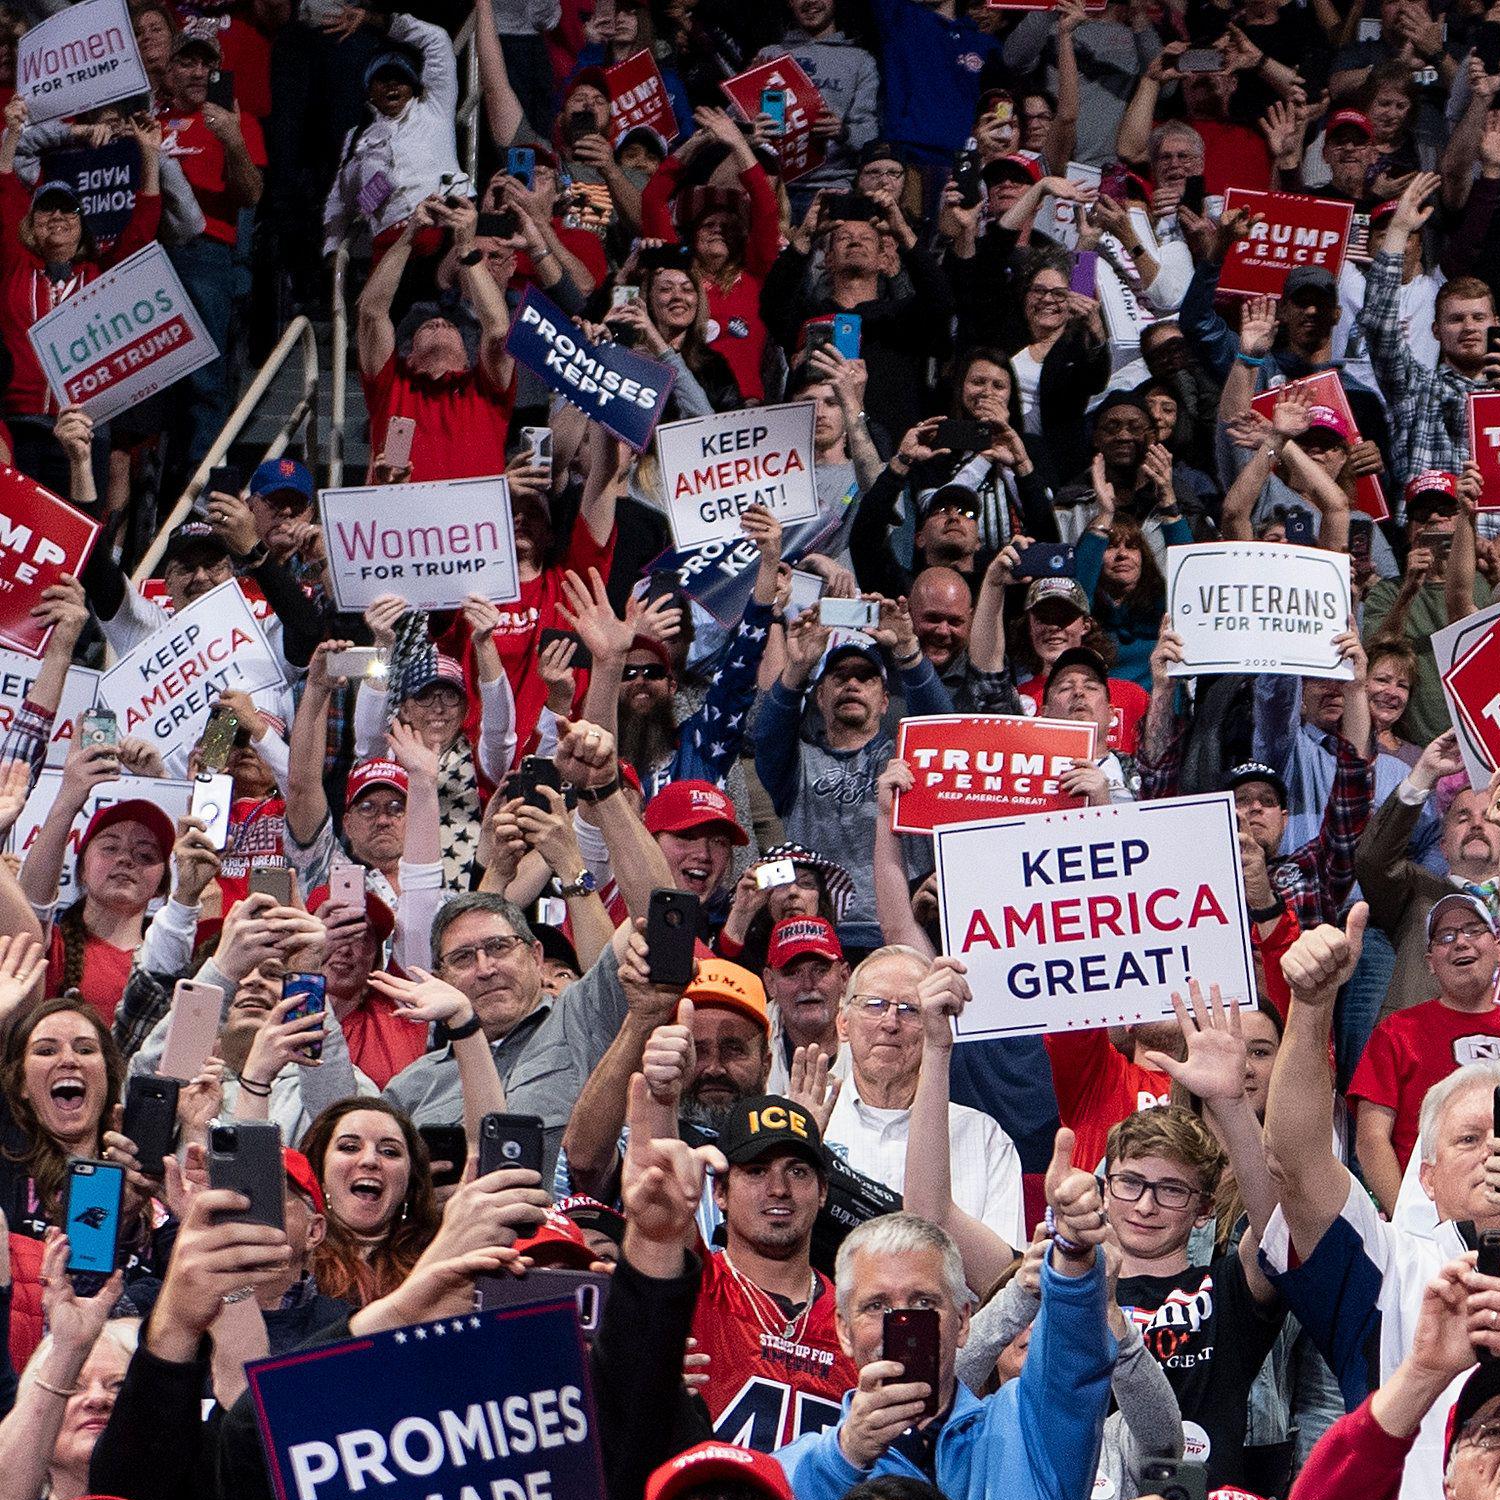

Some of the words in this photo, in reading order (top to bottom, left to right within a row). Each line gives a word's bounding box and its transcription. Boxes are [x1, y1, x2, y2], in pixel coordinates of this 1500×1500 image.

[22, 27, 126, 84] Women
[32, 79, 62, 96] FOR
[67, 59, 119, 85] TRUMP
[607, 77, 659, 117] RUMP
[615, 96, 662, 130] ENCE
[78, 165, 130, 191] MADE
[1236, 241, 1326, 264] PENCE
[1250, 224, 1340, 246] RUMP
[50, 291, 174, 375] Latinos
[69, 366, 111, 402] FOR
[112, 327, 186, 381] TRUMP
[521, 305, 657, 410] PROMISES
[545, 349, 617, 407] KEPT
[701, 427, 768, 459] KEEP
[674, 448, 804, 500] AMERICA
[336, 518, 499, 561] Women
[361, 561, 405, 580] FOR
[412, 557, 487, 578] TRUMP
[1199, 584, 1337, 619] VETERANS
[1214, 616, 1250, 633] FOR
[1257, 617, 1324, 635] TRUMP
[139, 623, 202, 679] KEEP
[1245, 659, 1277, 667] 2020
[125, 629, 254, 732] AMERICA
[913, 749, 1074, 774] TRUMP
[926, 772, 1059, 795] PENCE
[938, 791, 962, 802] KEEP
[964, 792, 1009, 804] AMERICA
[1011, 795, 1047, 806] GREAT!
[1022, 839, 1150, 887] KEEP
[961, 884, 1230, 953] AMERICA
[694, 974, 746, 996] RUMP
[1007, 945, 1191, 999] GREAT!
[747, 1106, 809, 1137] ICE
[795, 1344, 810, 1359] UP
[811, 1350, 835, 1367] FOR
